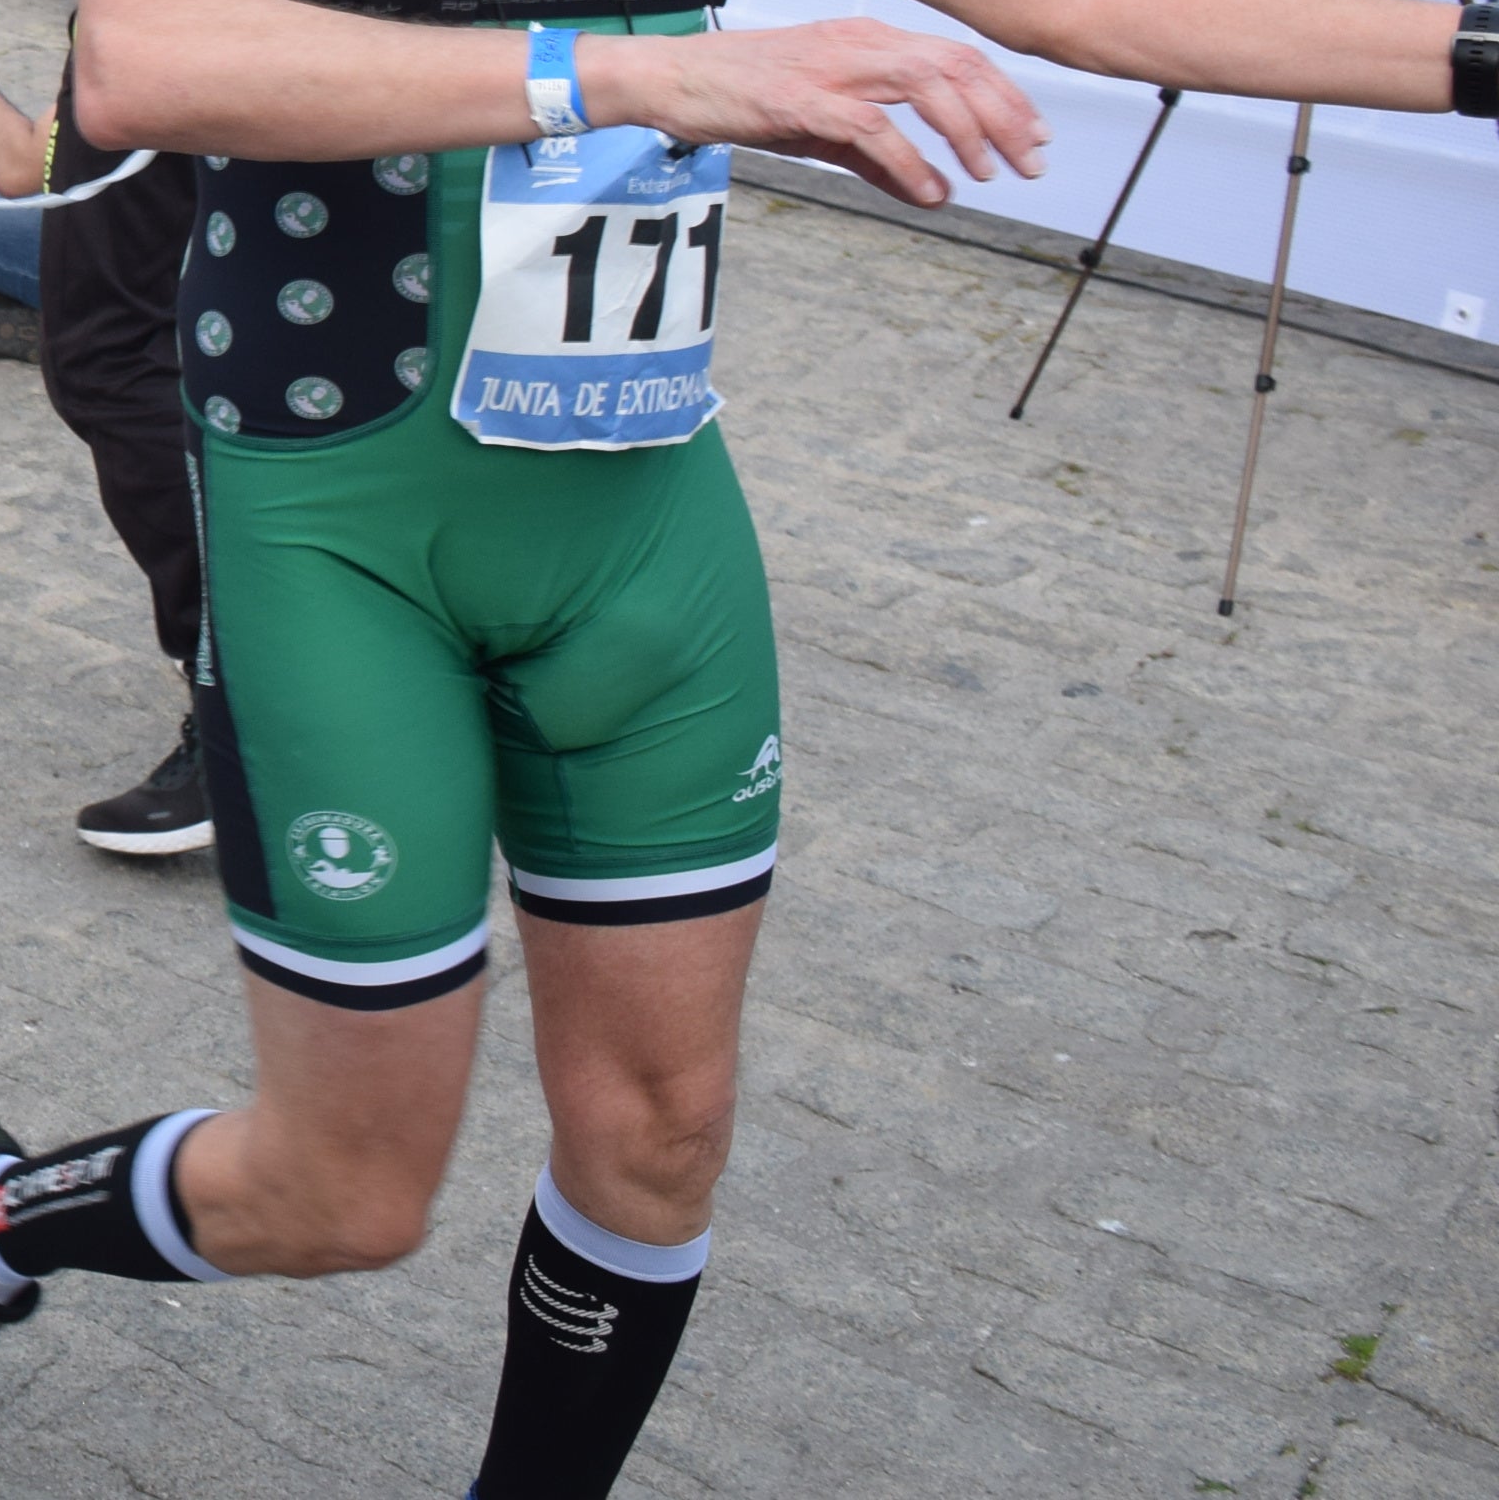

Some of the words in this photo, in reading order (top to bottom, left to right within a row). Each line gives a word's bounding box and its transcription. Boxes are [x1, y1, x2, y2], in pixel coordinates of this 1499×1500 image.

[551, 203, 724, 343] 171
[475, 376, 562, 418] JUNTA
[573, 380, 609, 417] DE
